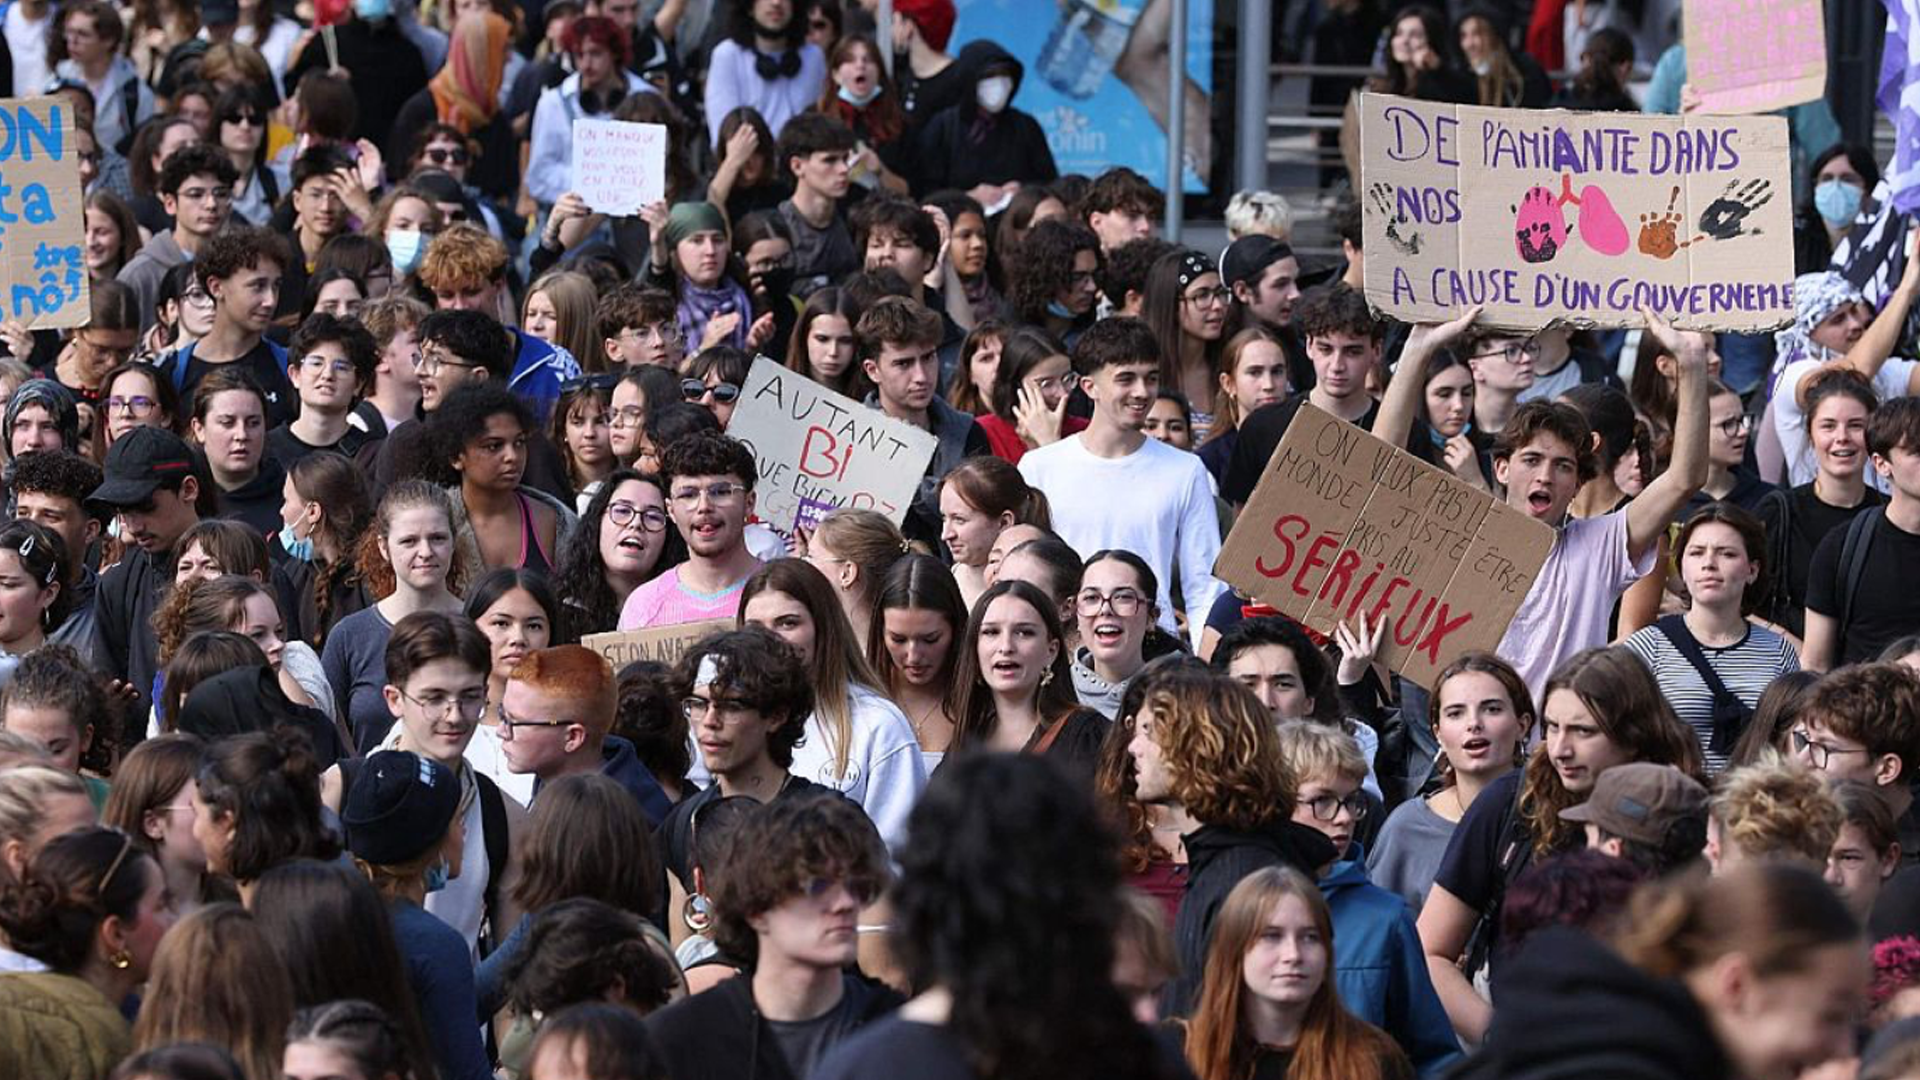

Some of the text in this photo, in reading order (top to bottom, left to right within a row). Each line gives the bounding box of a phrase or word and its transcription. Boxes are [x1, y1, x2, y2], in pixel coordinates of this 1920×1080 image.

[1385, 107, 1460, 166] DE
[1650, 129, 1739, 175] DANS
[1397, 186, 1462, 225] NOS
[1431, 267, 1521, 306] CAUSE
[1534, 273, 1600, 310] D'UN
[754, 375, 908, 461] AUTANT
[1315, 421, 1358, 466] ON
[1424, 479, 1468, 522] PAS
[1276, 446, 1363, 509] MONDE
[1391, 505, 1472, 562] JUSTE
[1354, 519, 1421, 576] PRIS AU
[629, 640, 650, 662] ON
